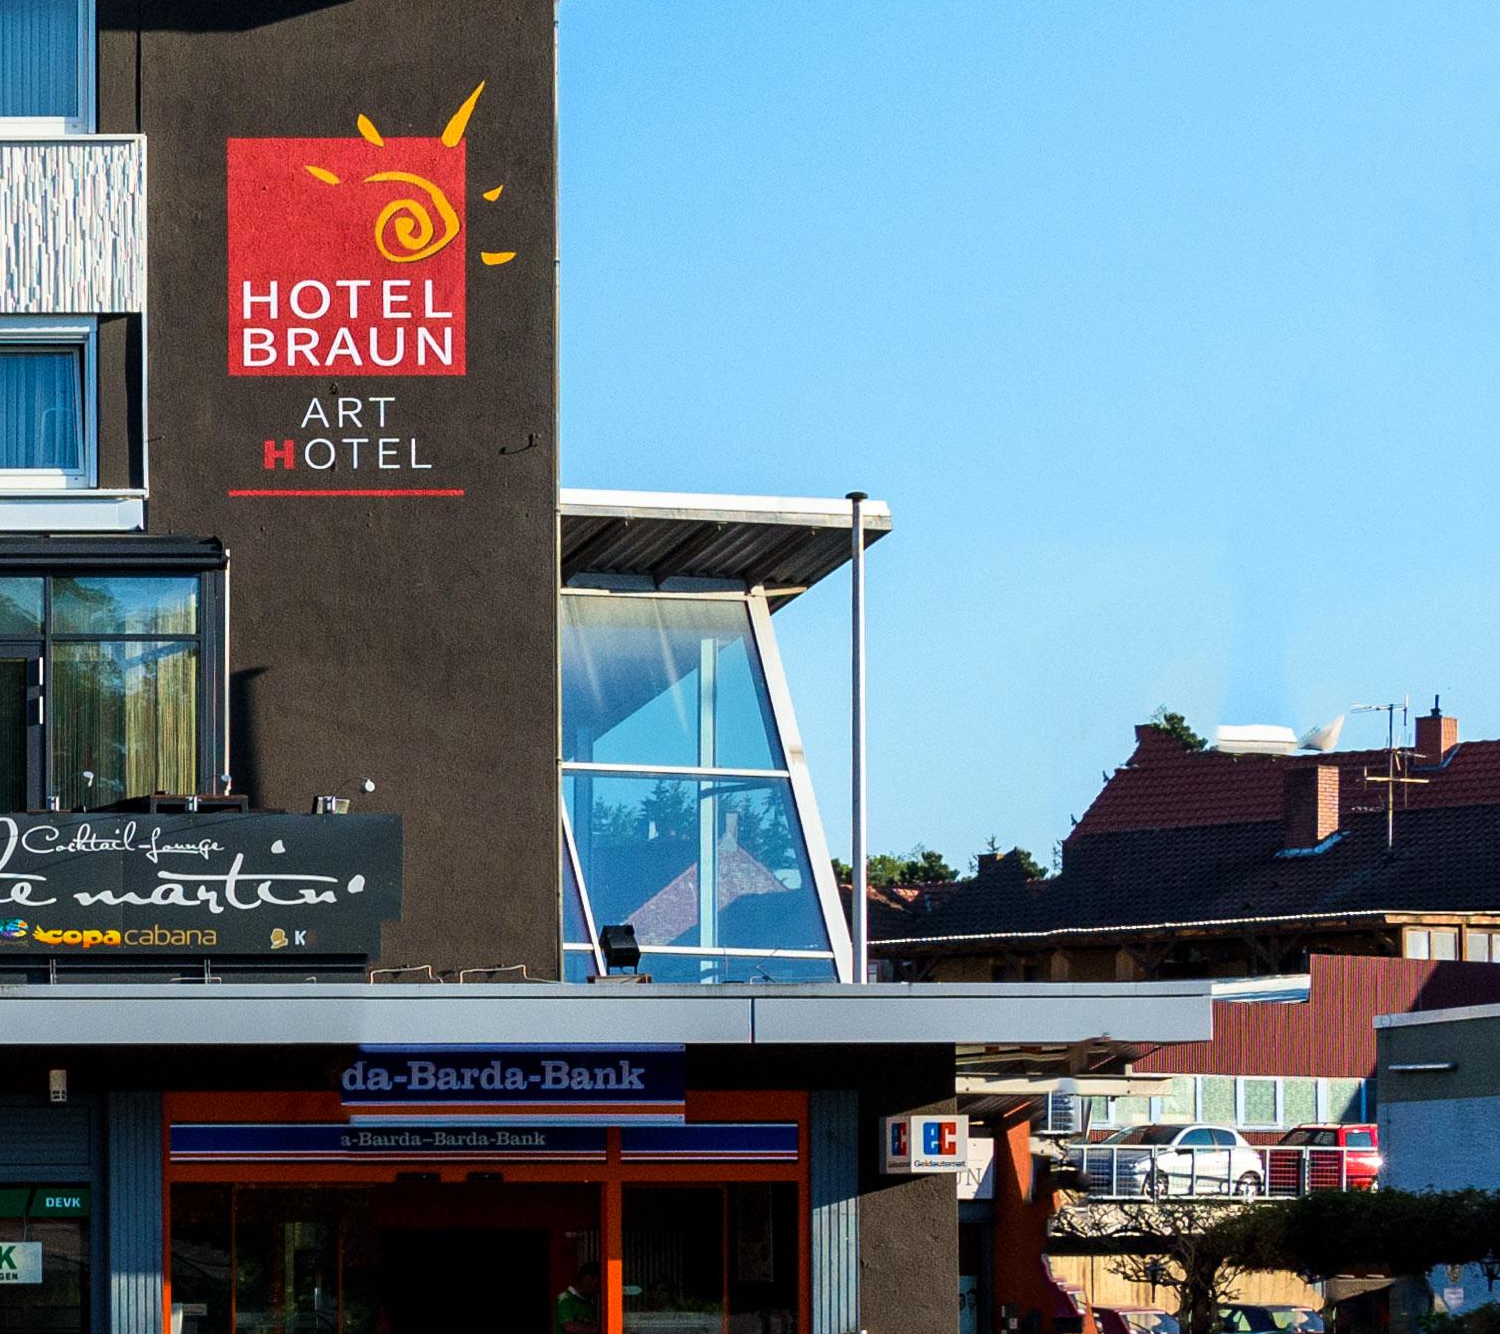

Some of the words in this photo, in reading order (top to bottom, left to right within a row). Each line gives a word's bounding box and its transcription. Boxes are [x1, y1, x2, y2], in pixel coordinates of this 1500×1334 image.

[242, 279, 453, 319] HOTEL
[242, 326, 453, 367] BRAUN
[301, 397, 396, 428] ART
[263, 438, 432, 470] HOTEL
[341, 1061, 645, 1091] da-Barda-Bank
[923, 1122, 957, 1155] ec
[45, 1197, 81, 1208] DEVK
